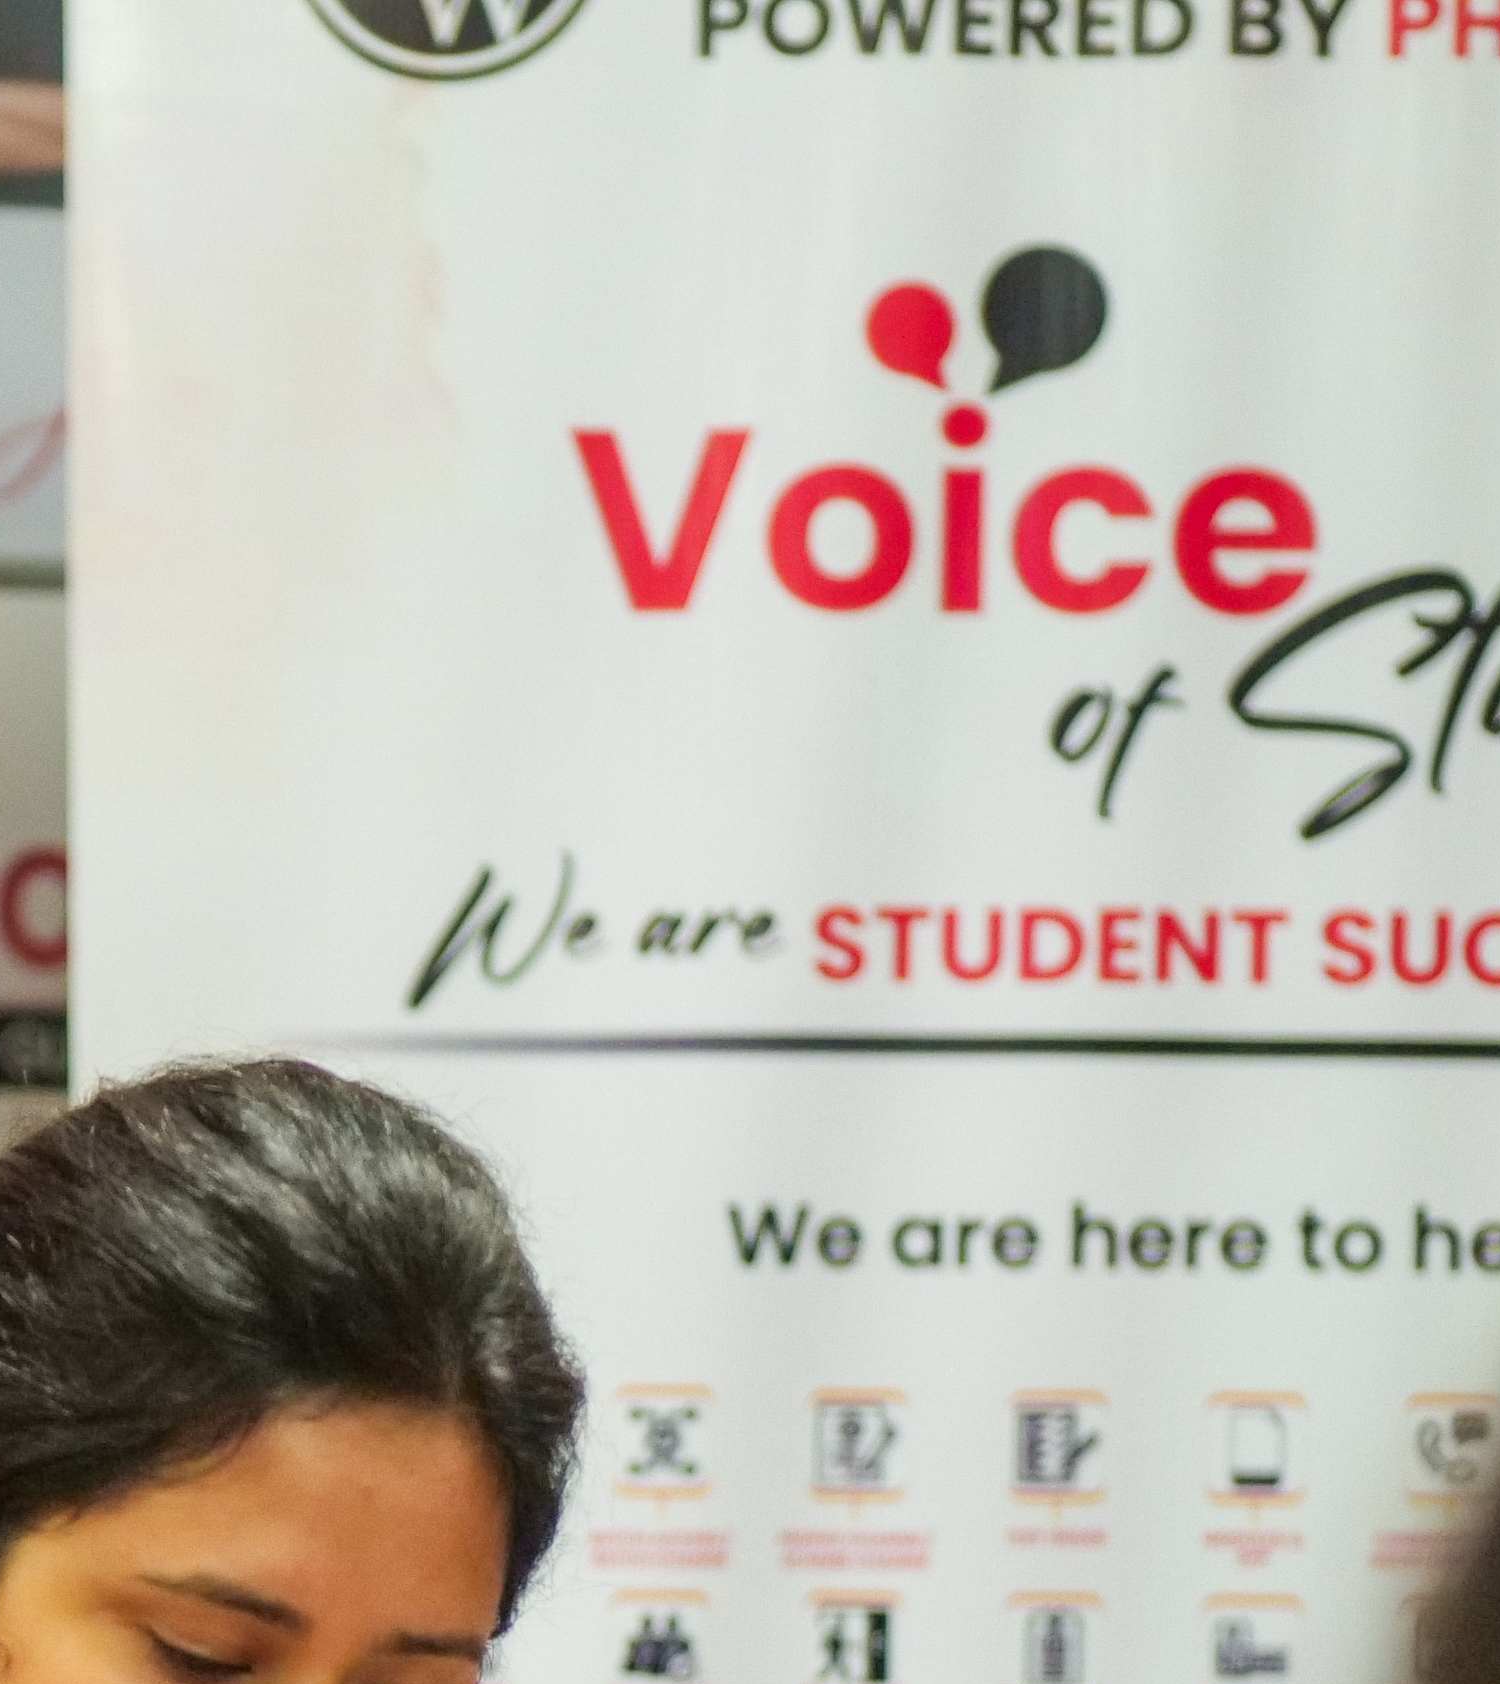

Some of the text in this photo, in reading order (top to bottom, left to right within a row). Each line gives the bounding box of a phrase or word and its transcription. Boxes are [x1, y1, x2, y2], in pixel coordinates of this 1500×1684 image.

[694, 0, 1192, 58] POWERED
[1230, 0, 1347, 58] BY
[571, 402, 1318, 616] Voice
[1049, 663, 1183, 820] of
[405, 850, 602, 1009] We
[637, 910, 784, 960] are
[815, 905, 1288, 986] STUDENT
[728, 1203, 862, 1270] We
[892, 1217, 1039, 1270] are
[1070, 1201, 1268, 1273] here
[1298, 1210, 1382, 1272] to
